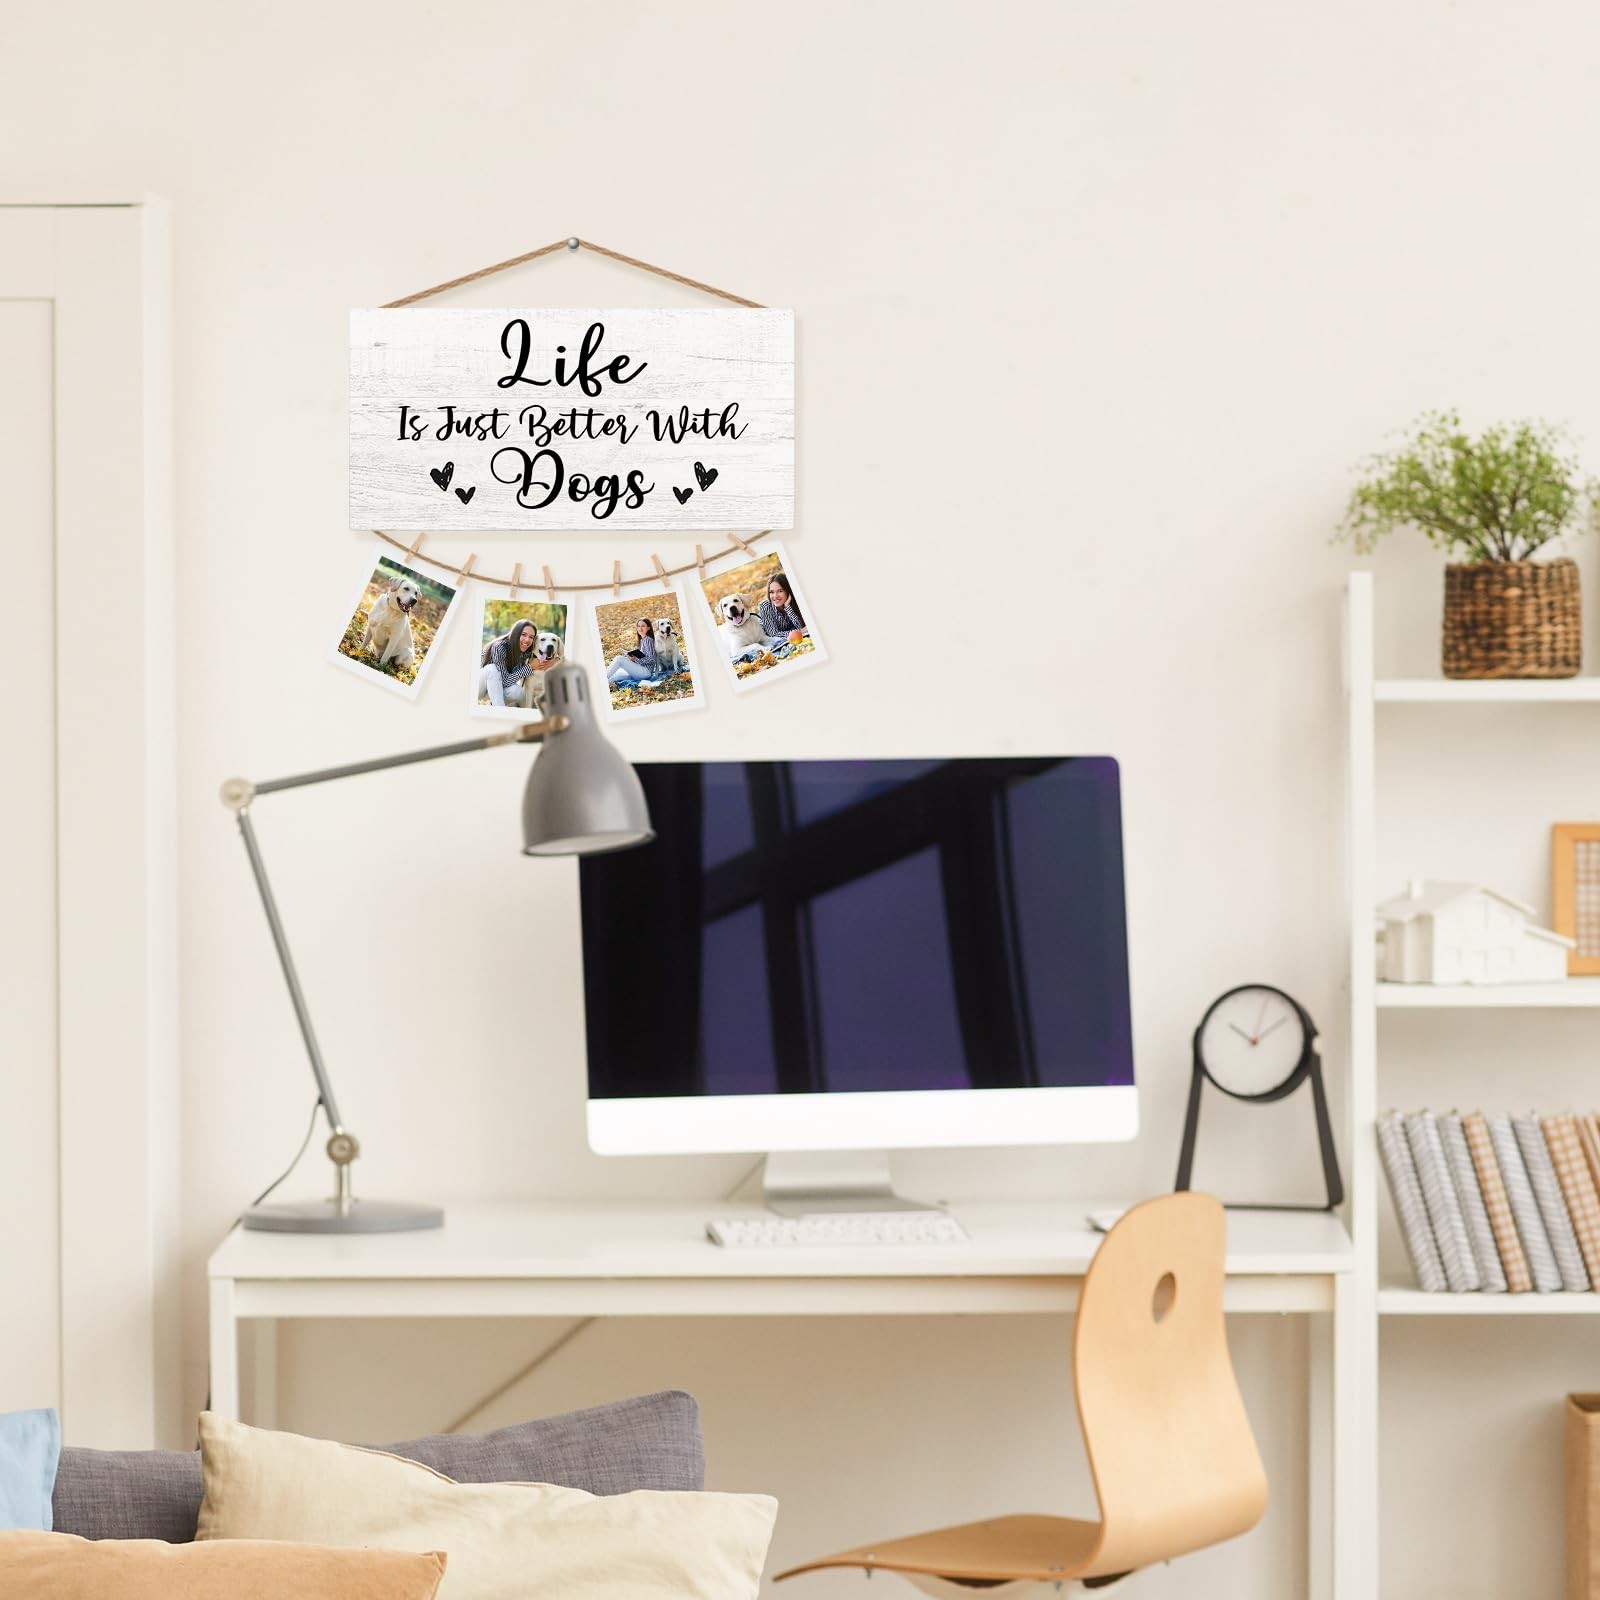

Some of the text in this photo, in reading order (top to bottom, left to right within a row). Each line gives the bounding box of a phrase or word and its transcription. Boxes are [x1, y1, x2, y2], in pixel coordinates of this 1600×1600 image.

[497, 318, 648, 398] Life
[397, 402, 749, 448] Is Just Better With
[490, 446, 656, 520] Dogs
